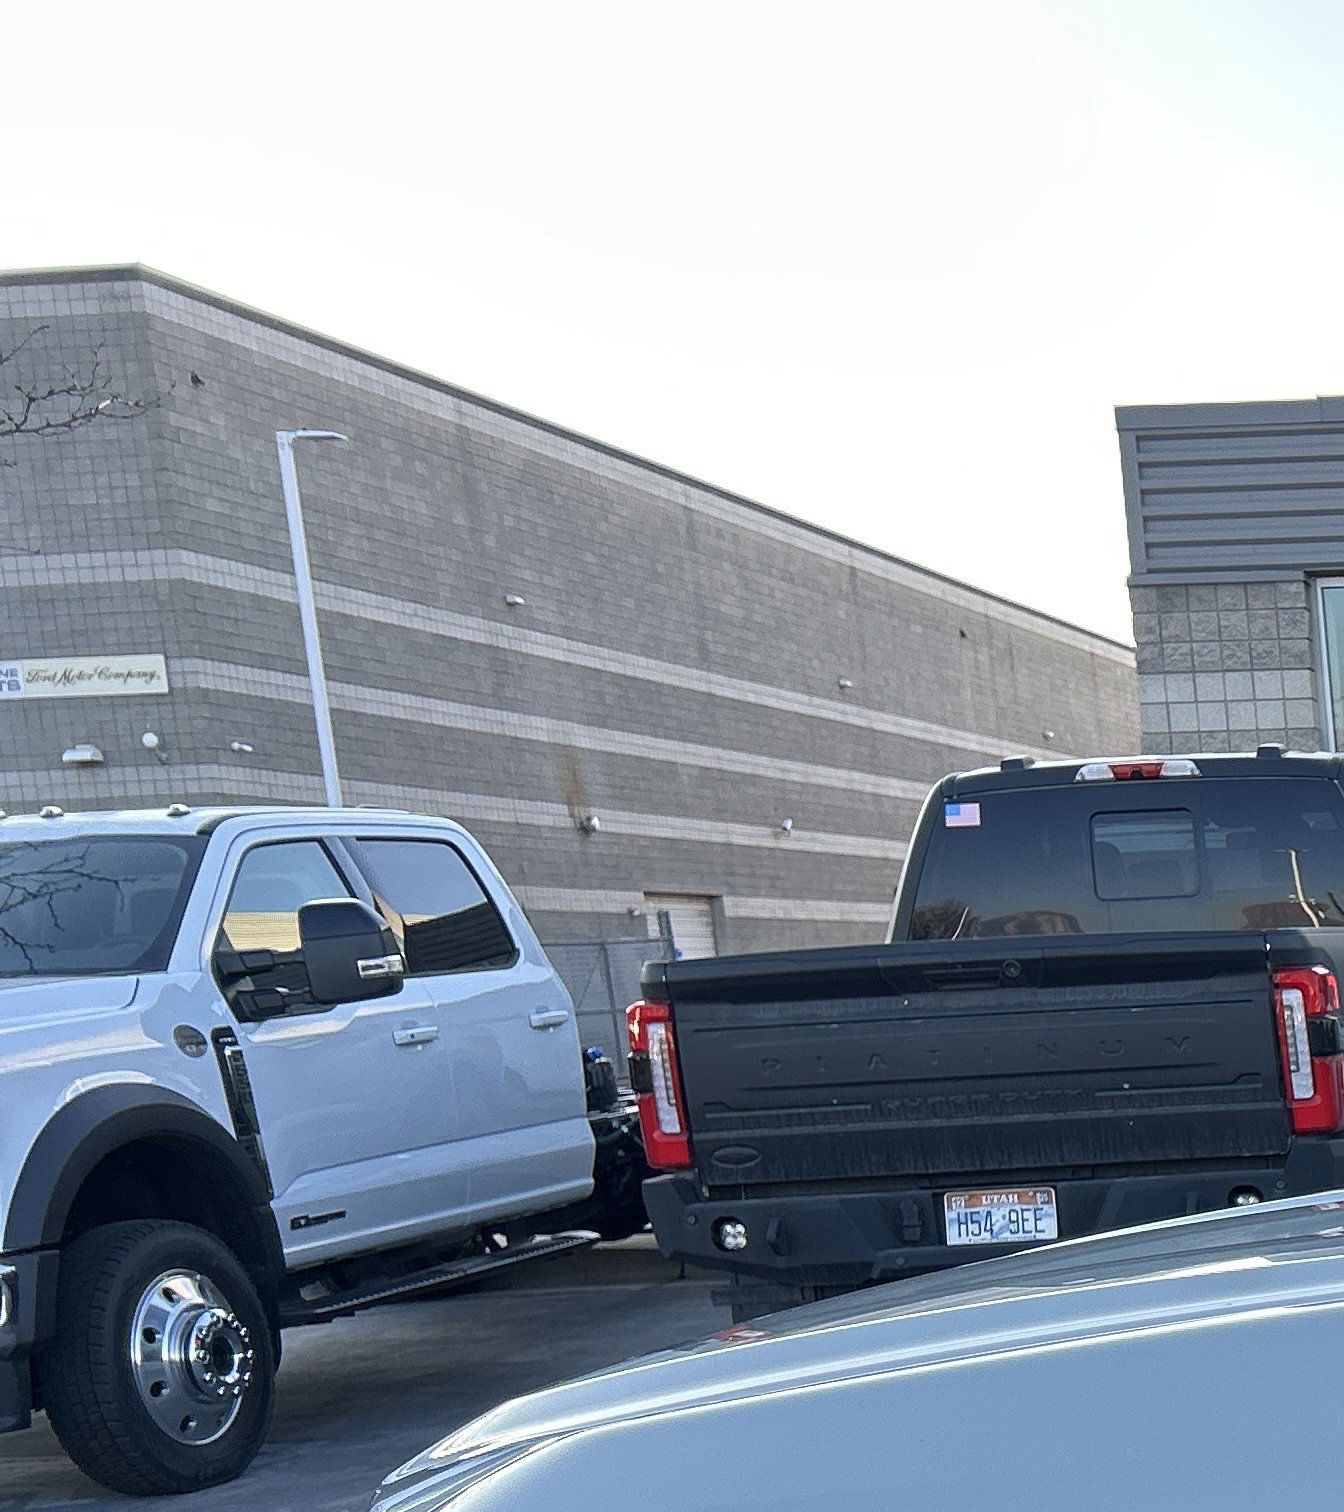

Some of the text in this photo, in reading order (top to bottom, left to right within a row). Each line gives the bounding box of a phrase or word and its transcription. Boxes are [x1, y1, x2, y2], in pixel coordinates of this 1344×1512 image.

[26, 669, 57, 685] Ford
[54, 668, 96, 687] Motor
[760, 1036, 1194, 1075] PLATINUM
[982, 1193, 1019, 1204] UTAH
[957, 1207, 1046, 1238] H54 9EE
